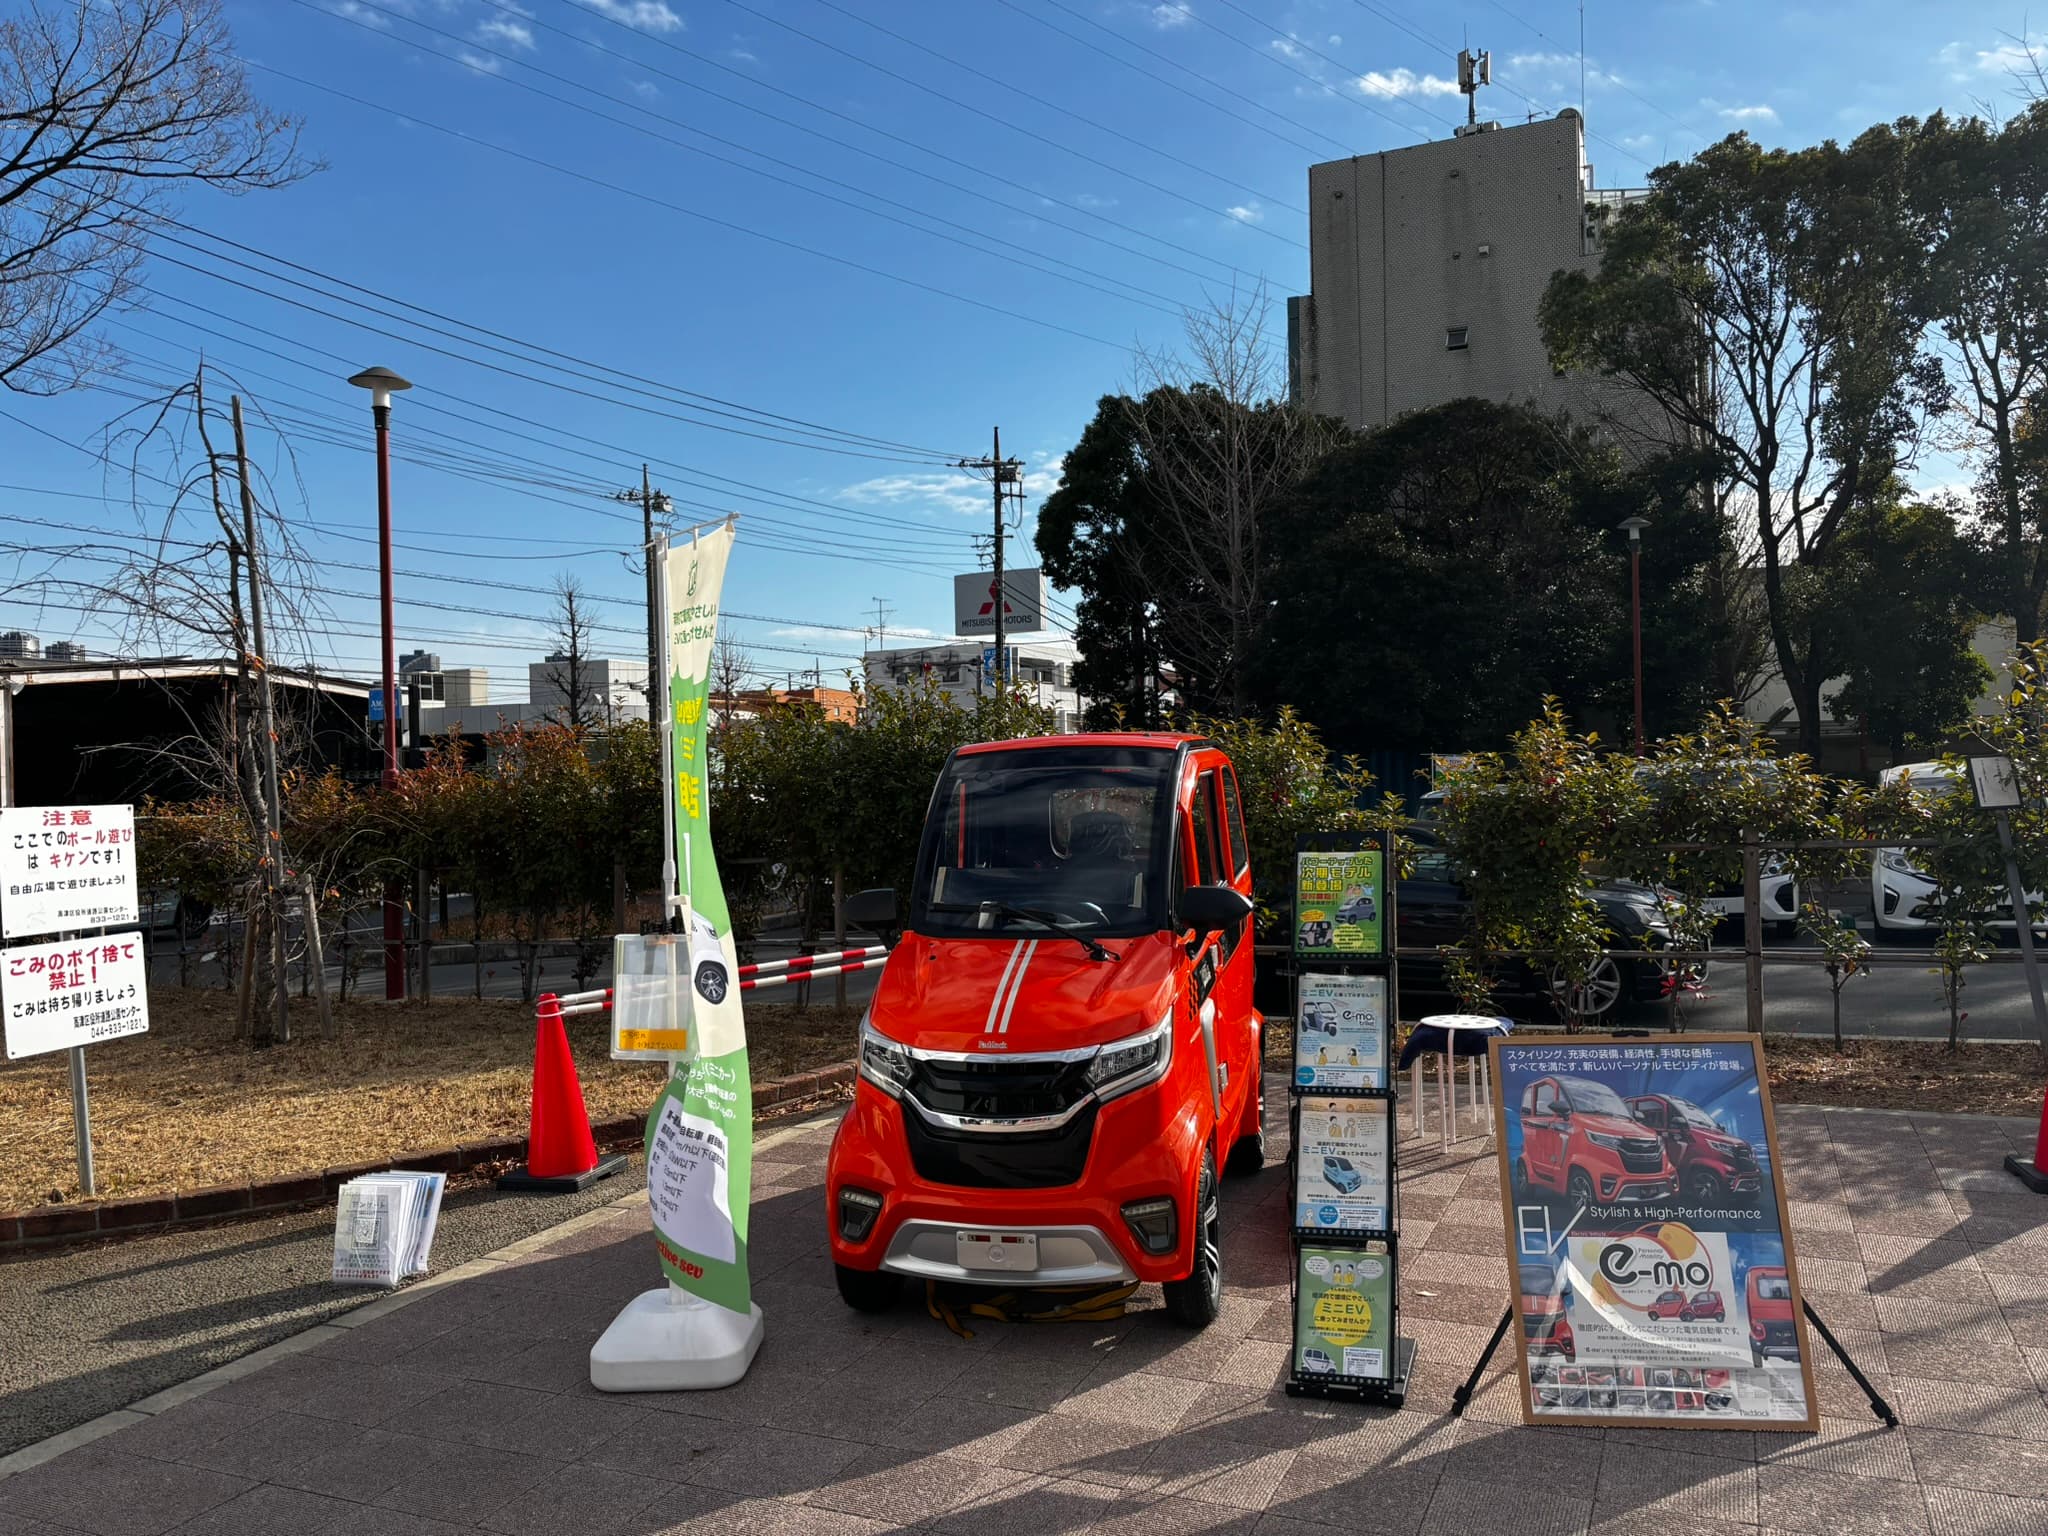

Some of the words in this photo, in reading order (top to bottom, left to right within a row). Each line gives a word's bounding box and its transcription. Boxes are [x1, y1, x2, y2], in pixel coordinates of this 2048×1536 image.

[962, 618, 995, 628] MITSUBIS
[42, 809, 92, 826] 注意
[10, 943, 135, 976] ごみのポイ捨て
[13, 984, 136, 1018] ごみは持ち帰りましょう
[1590, 1206, 1631, 1220] Stylish
[1634, 1208, 1642, 1218] &
[1645, 1206, 1762, 1220] High-Performance
[1518, 1206, 1586, 1255] EV
[1599, 1243, 1710, 1286] e-mo
[1322, 1302, 1365, 1315] ミニEV
